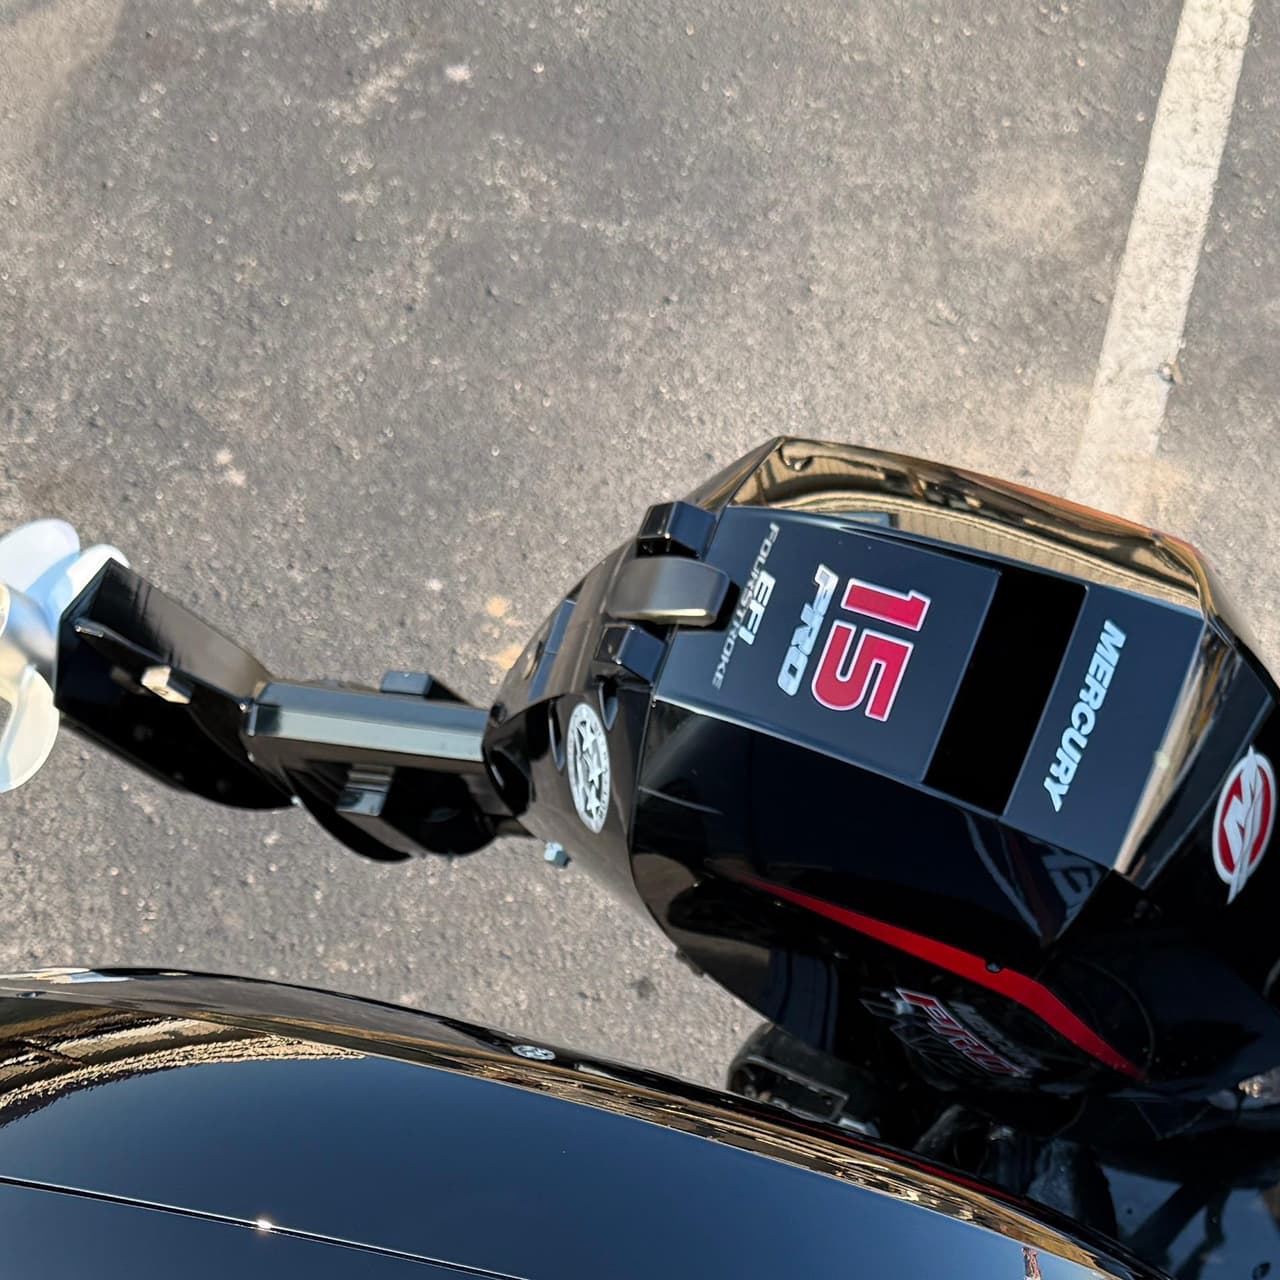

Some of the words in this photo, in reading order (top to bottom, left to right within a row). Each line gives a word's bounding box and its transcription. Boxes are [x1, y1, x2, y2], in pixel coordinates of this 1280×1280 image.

[738, 570, 776, 645] EFI
[777, 563, 839, 696] PRO
[811, 577, 931, 722] 15
[1043, 619, 1127, 812] MERCURY
